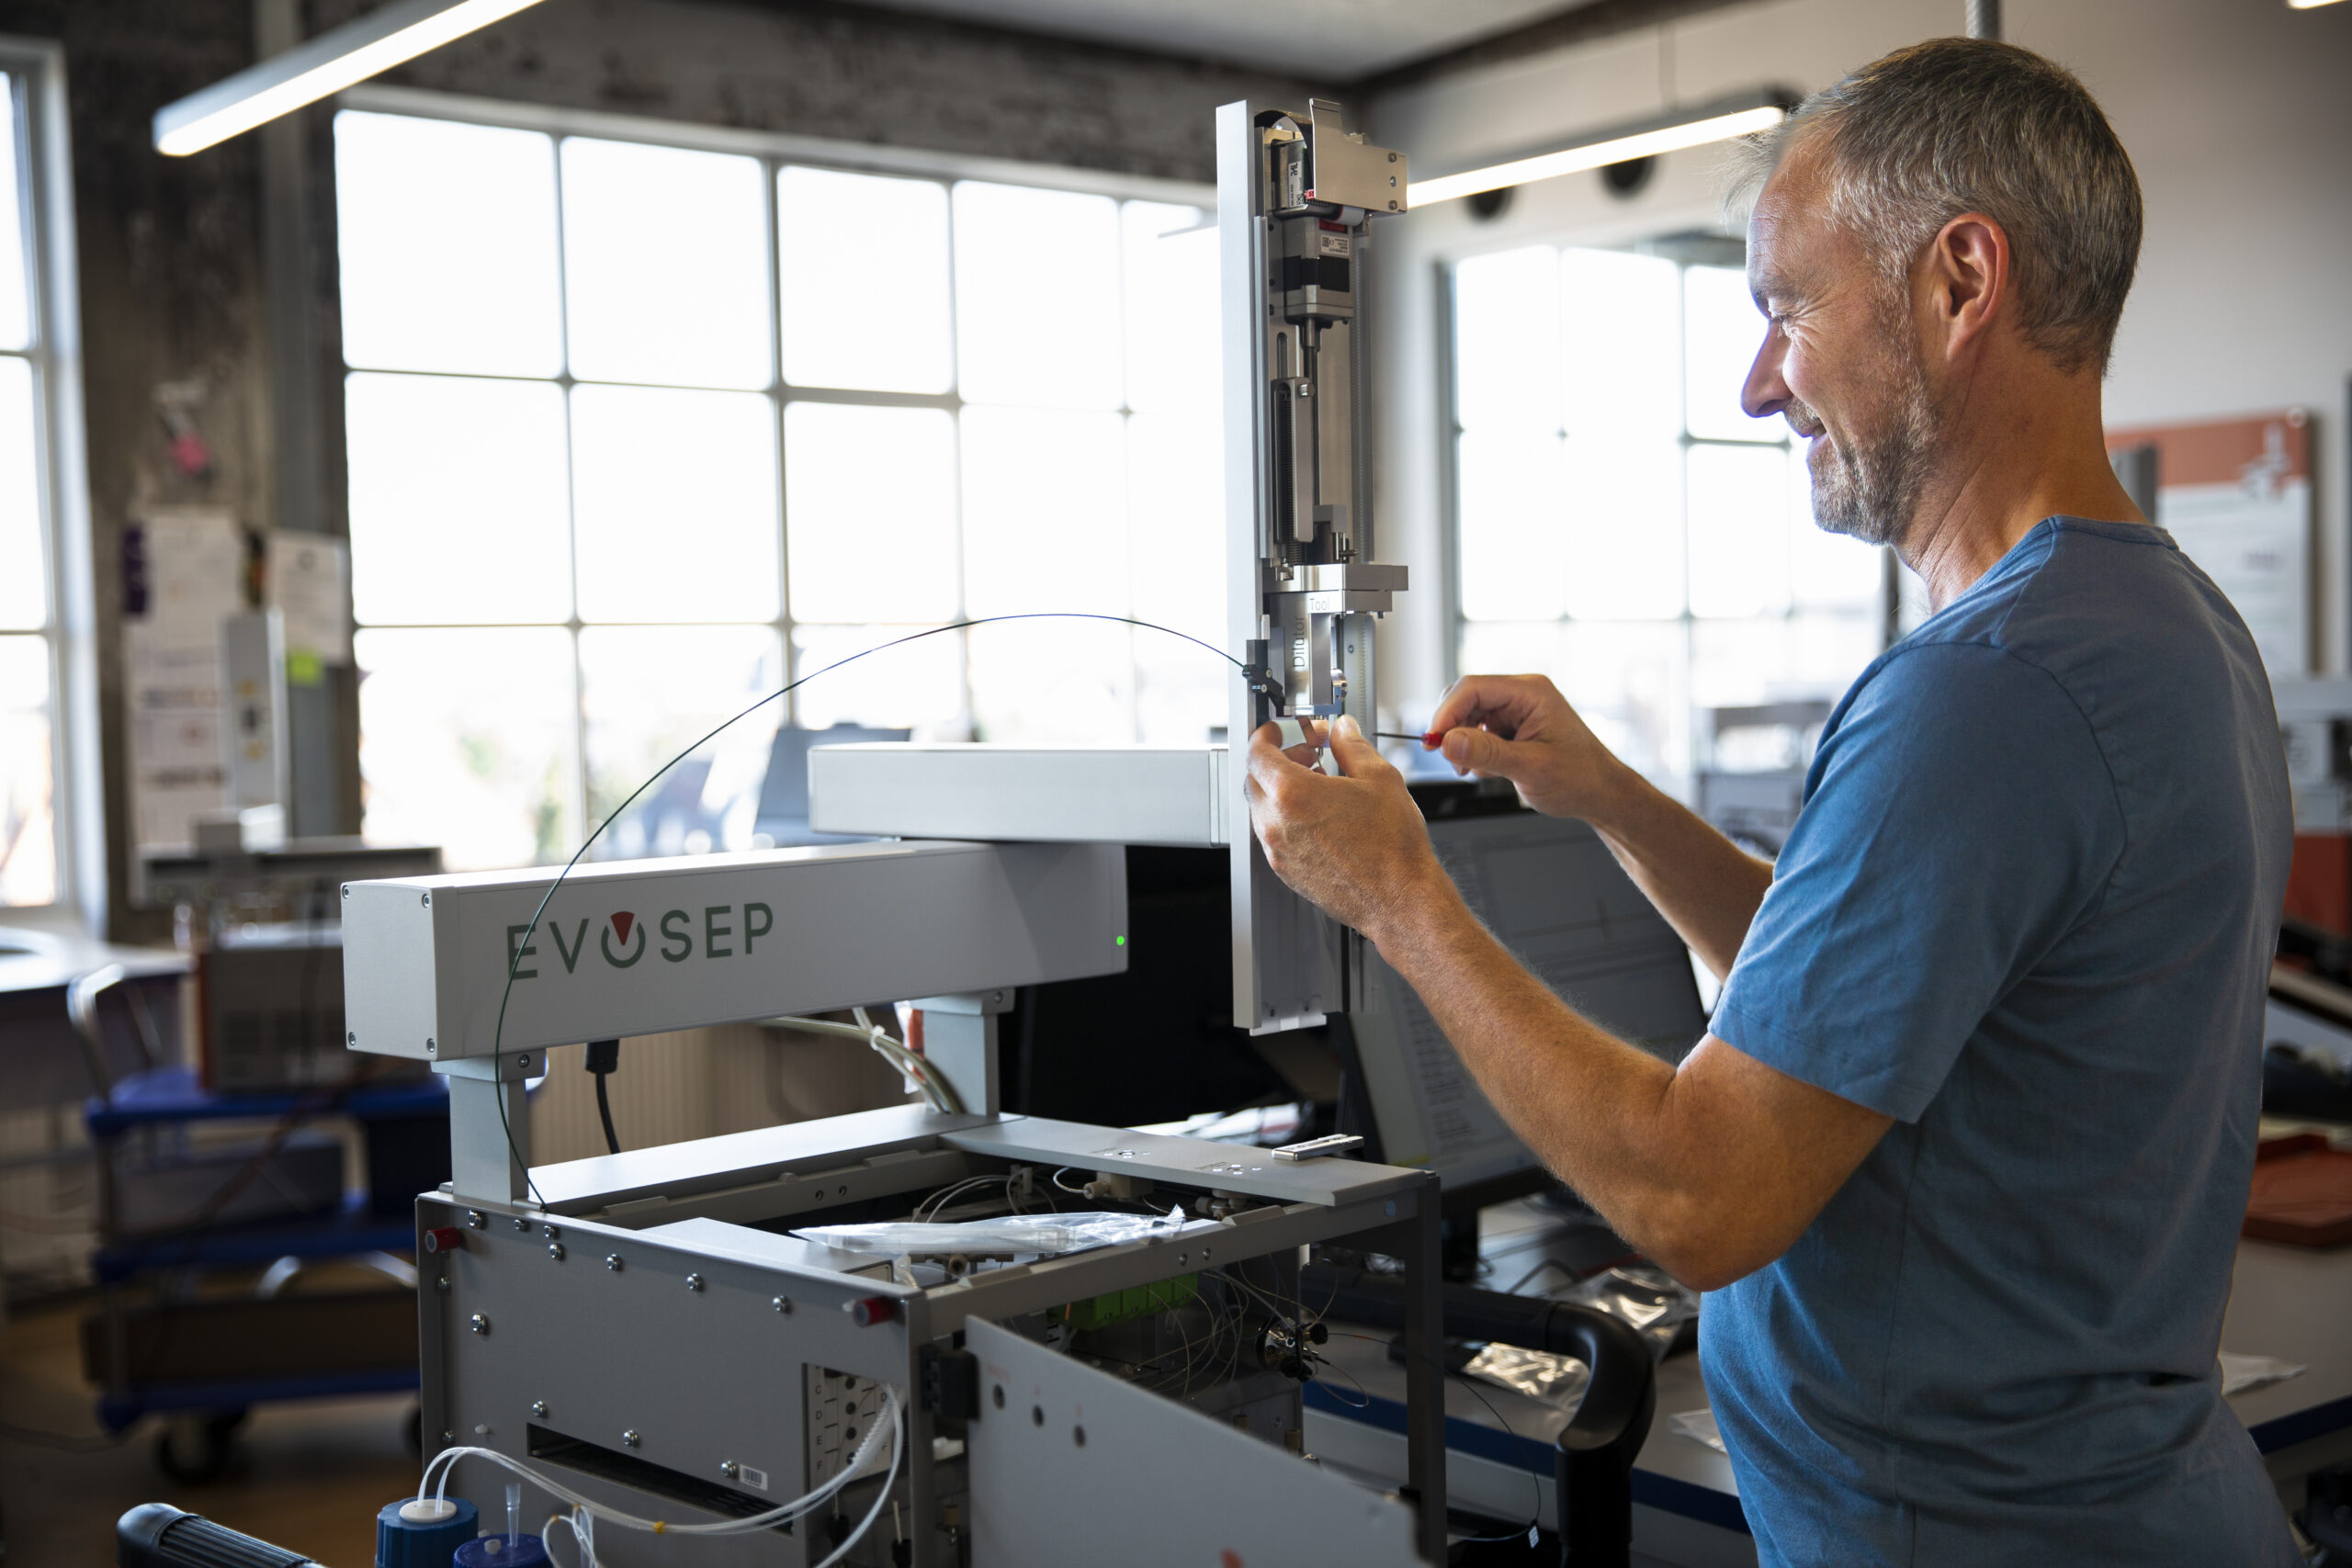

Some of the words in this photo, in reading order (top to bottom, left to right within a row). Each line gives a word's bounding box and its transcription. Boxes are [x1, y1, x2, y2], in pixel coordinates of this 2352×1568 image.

[1309, 597, 1330, 611] Tool
[1292, 616, 1306, 668] Dilutor
[506, 902, 774, 980] EVOSEP
[815, 1384, 822, 1394] C
[880, 1392, 888, 1402] D
[815, 1410, 822, 1420] D
[816, 1435, 823, 1446] E
[816, 1460, 823, 1471] F
